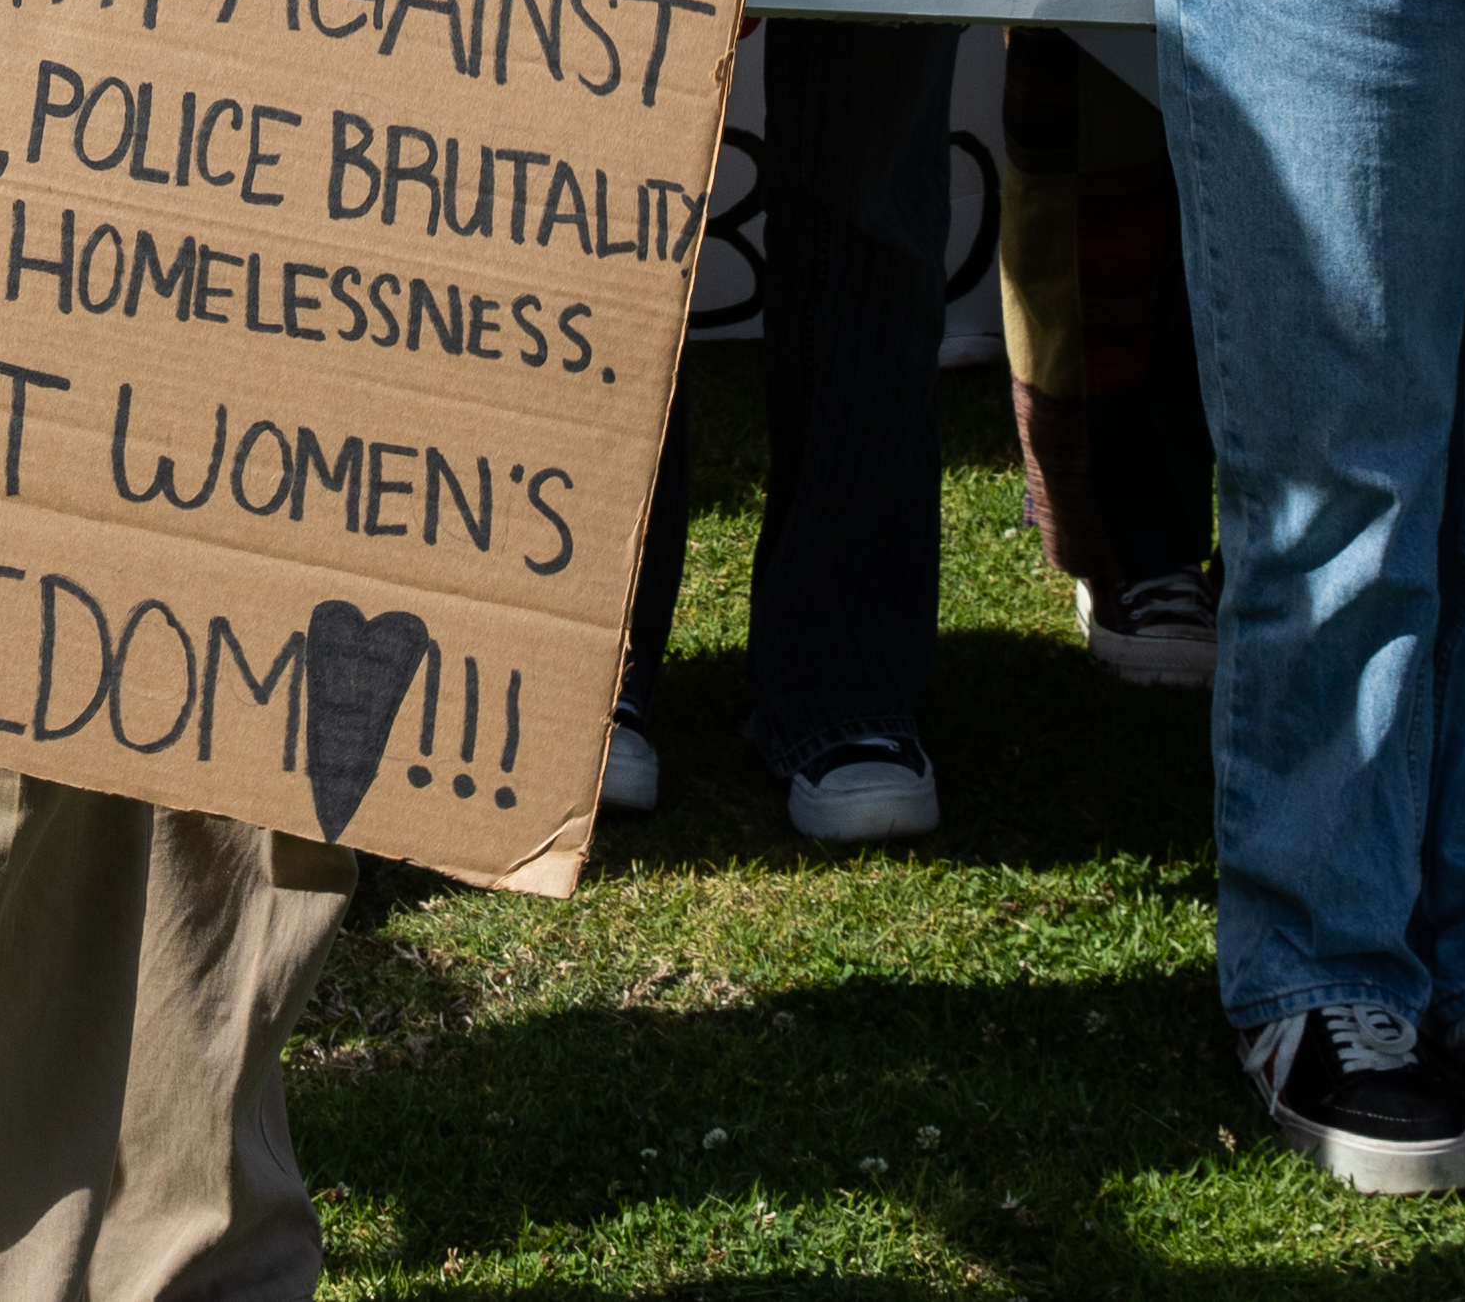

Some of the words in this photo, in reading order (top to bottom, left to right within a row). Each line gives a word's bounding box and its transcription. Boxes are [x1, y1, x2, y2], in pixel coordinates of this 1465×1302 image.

[25, 58, 304, 207] POLICE
[5, 201, 619, 385] HOMELESSNESS.
[112, 382, 575, 577] WOMEN'S
